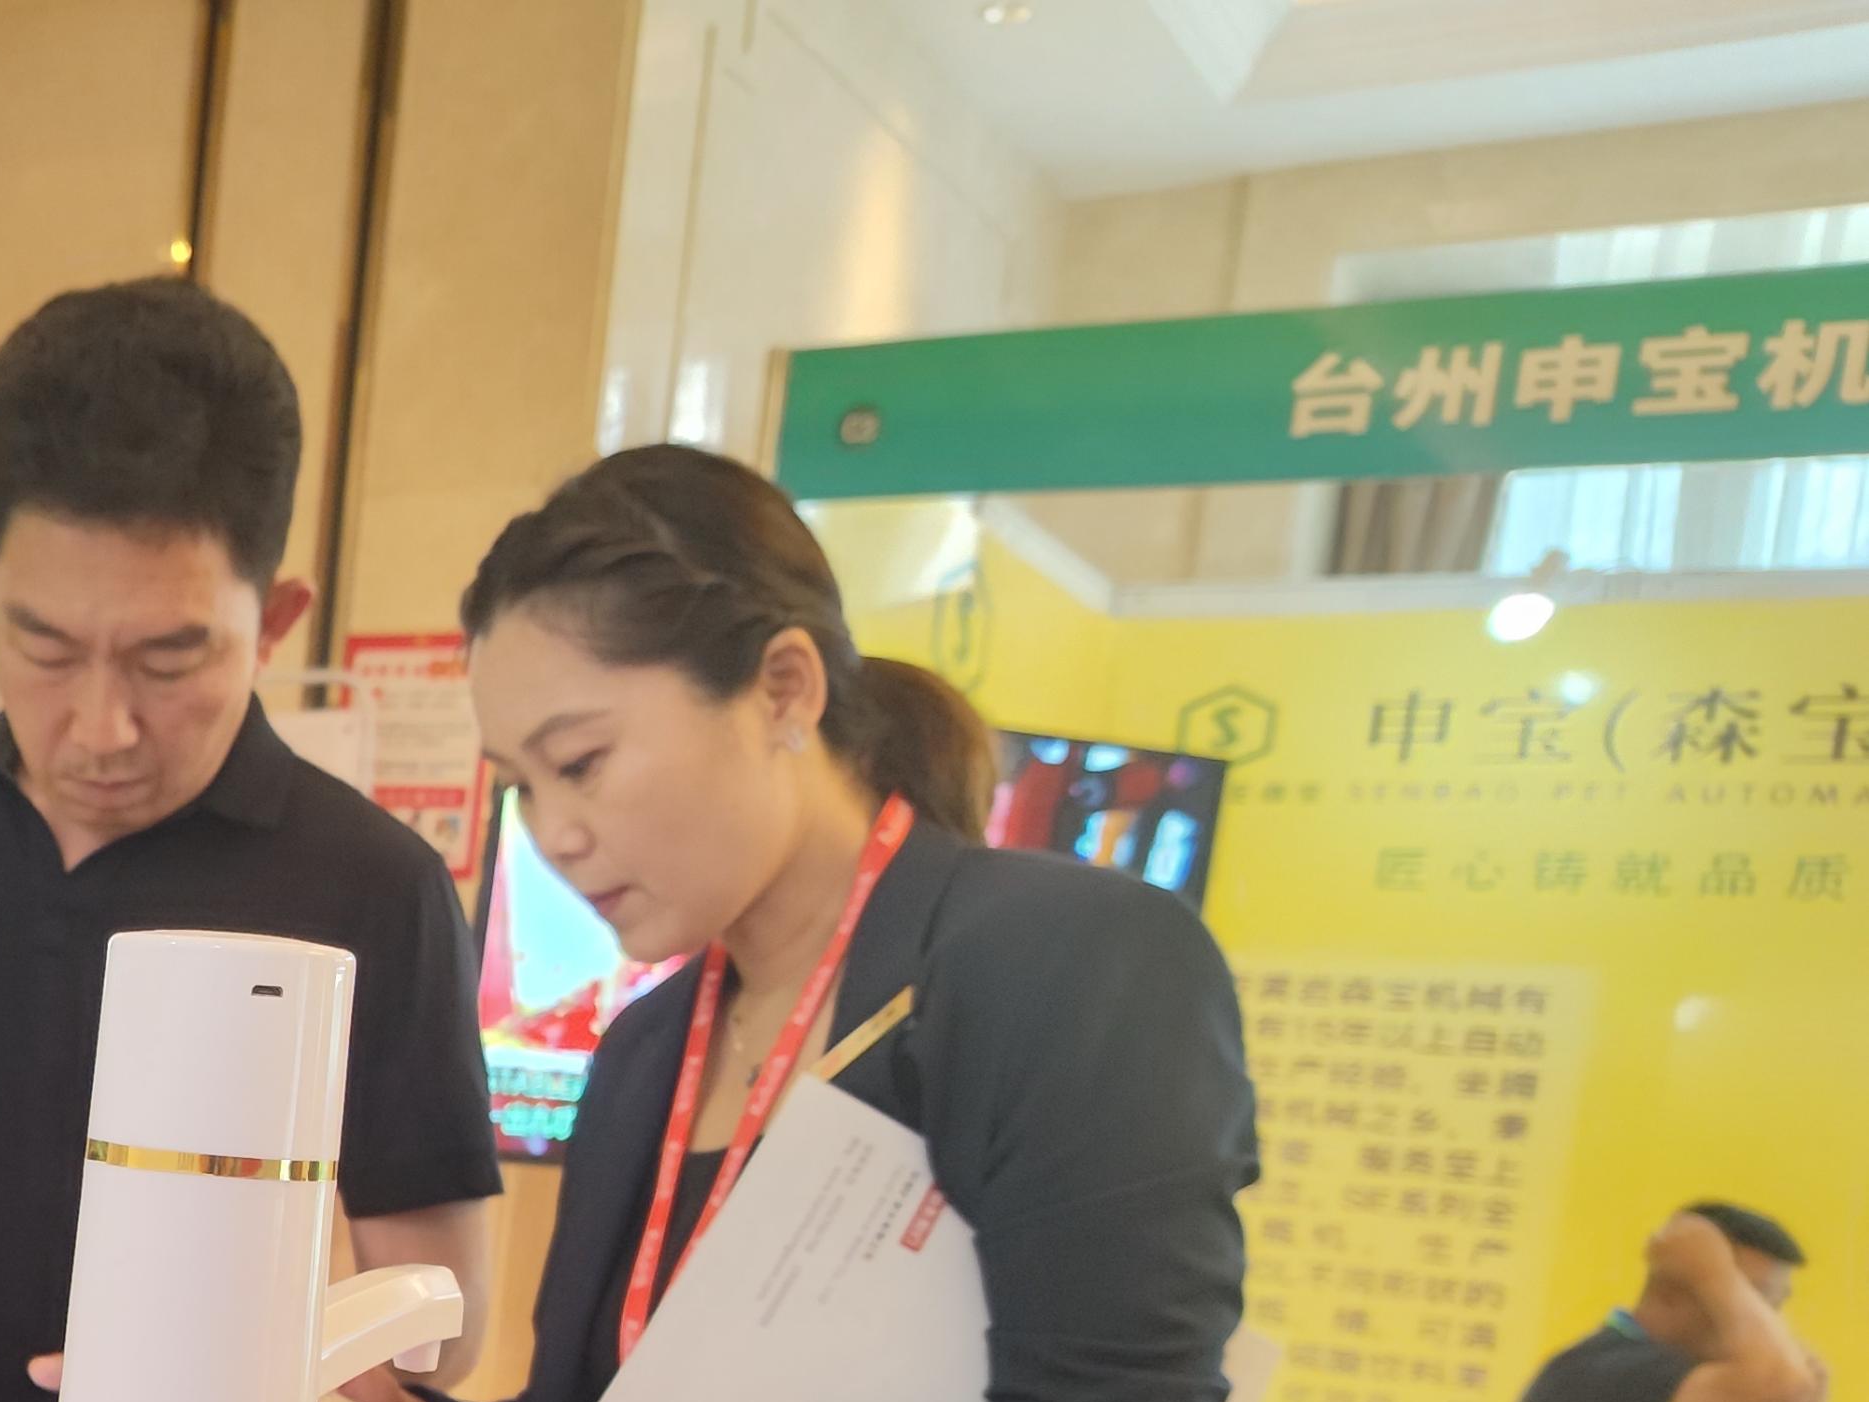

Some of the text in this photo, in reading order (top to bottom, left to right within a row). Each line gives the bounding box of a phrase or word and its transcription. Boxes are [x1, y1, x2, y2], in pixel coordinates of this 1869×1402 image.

[1288, 317, 1869, 438] 台州申宝机
[1374, 846, 1850, 903] 匠心铸就品质
